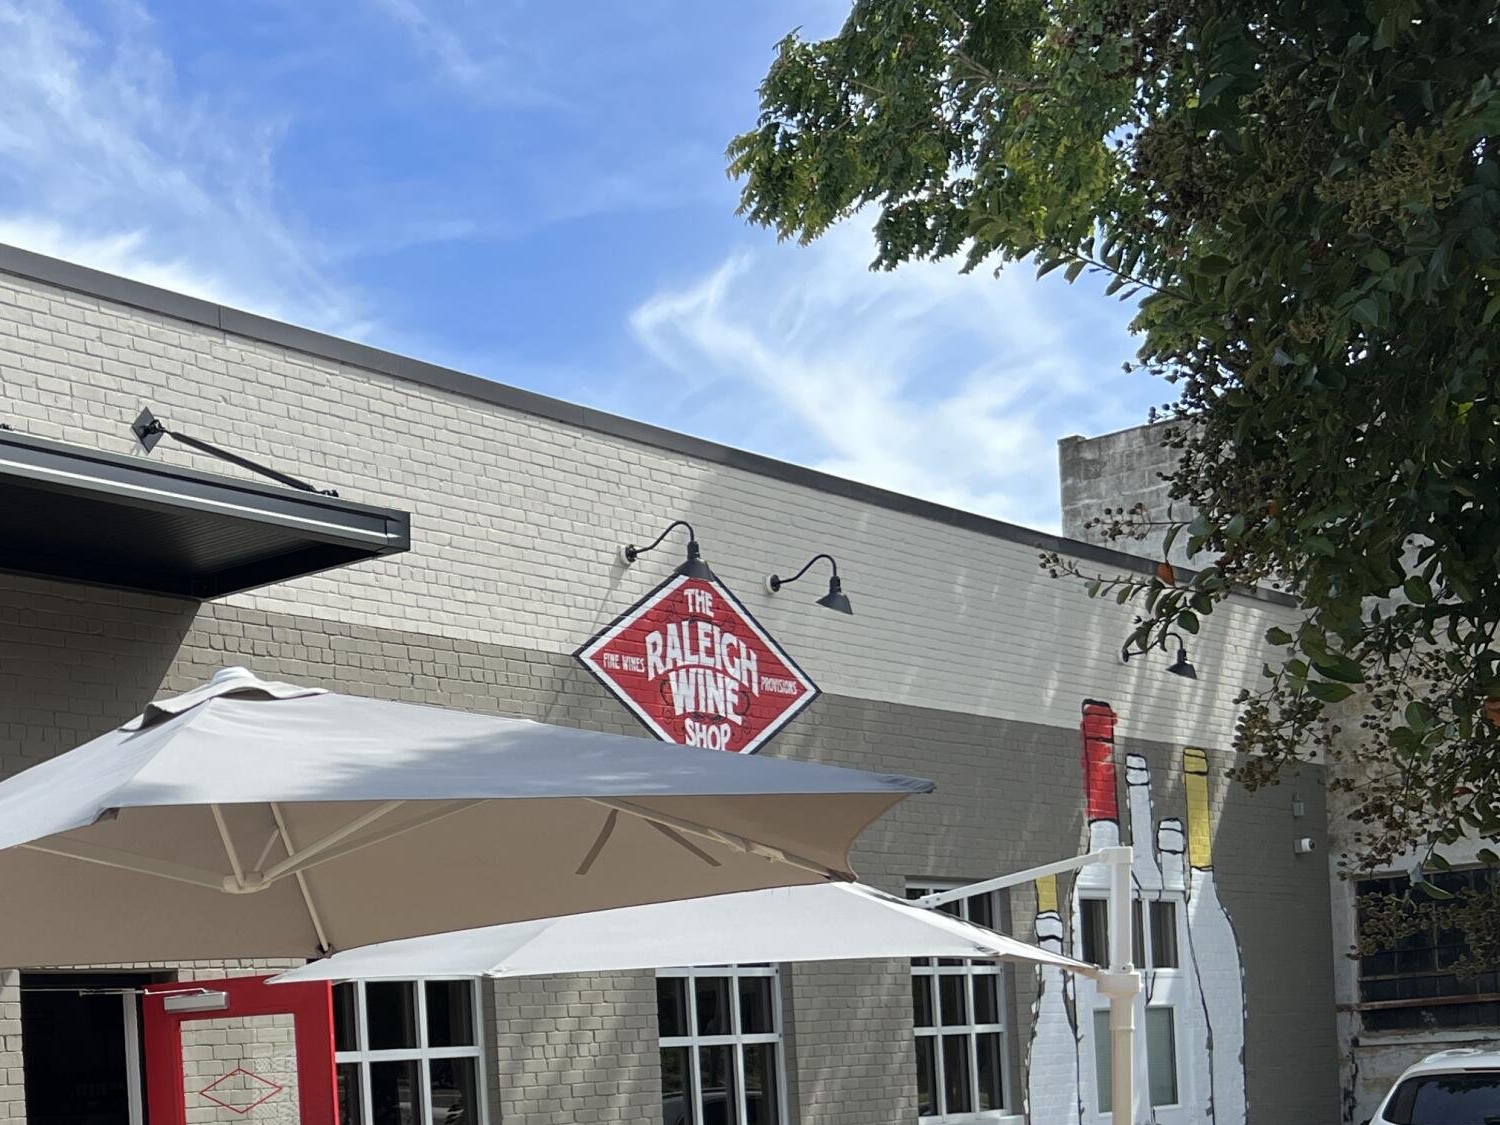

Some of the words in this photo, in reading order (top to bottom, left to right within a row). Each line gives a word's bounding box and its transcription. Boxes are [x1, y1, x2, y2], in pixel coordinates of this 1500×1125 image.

[684, 588, 714, 617] THE
[603, 652, 621, 670] FINE
[621, 654, 646, 673] WINES
[645, 620, 760, 697] RALEIGH
[668, 667, 742, 725] WINE
[760, 676, 798, 695] PROVISIONS
[684, 717, 731, 751] SHOP
